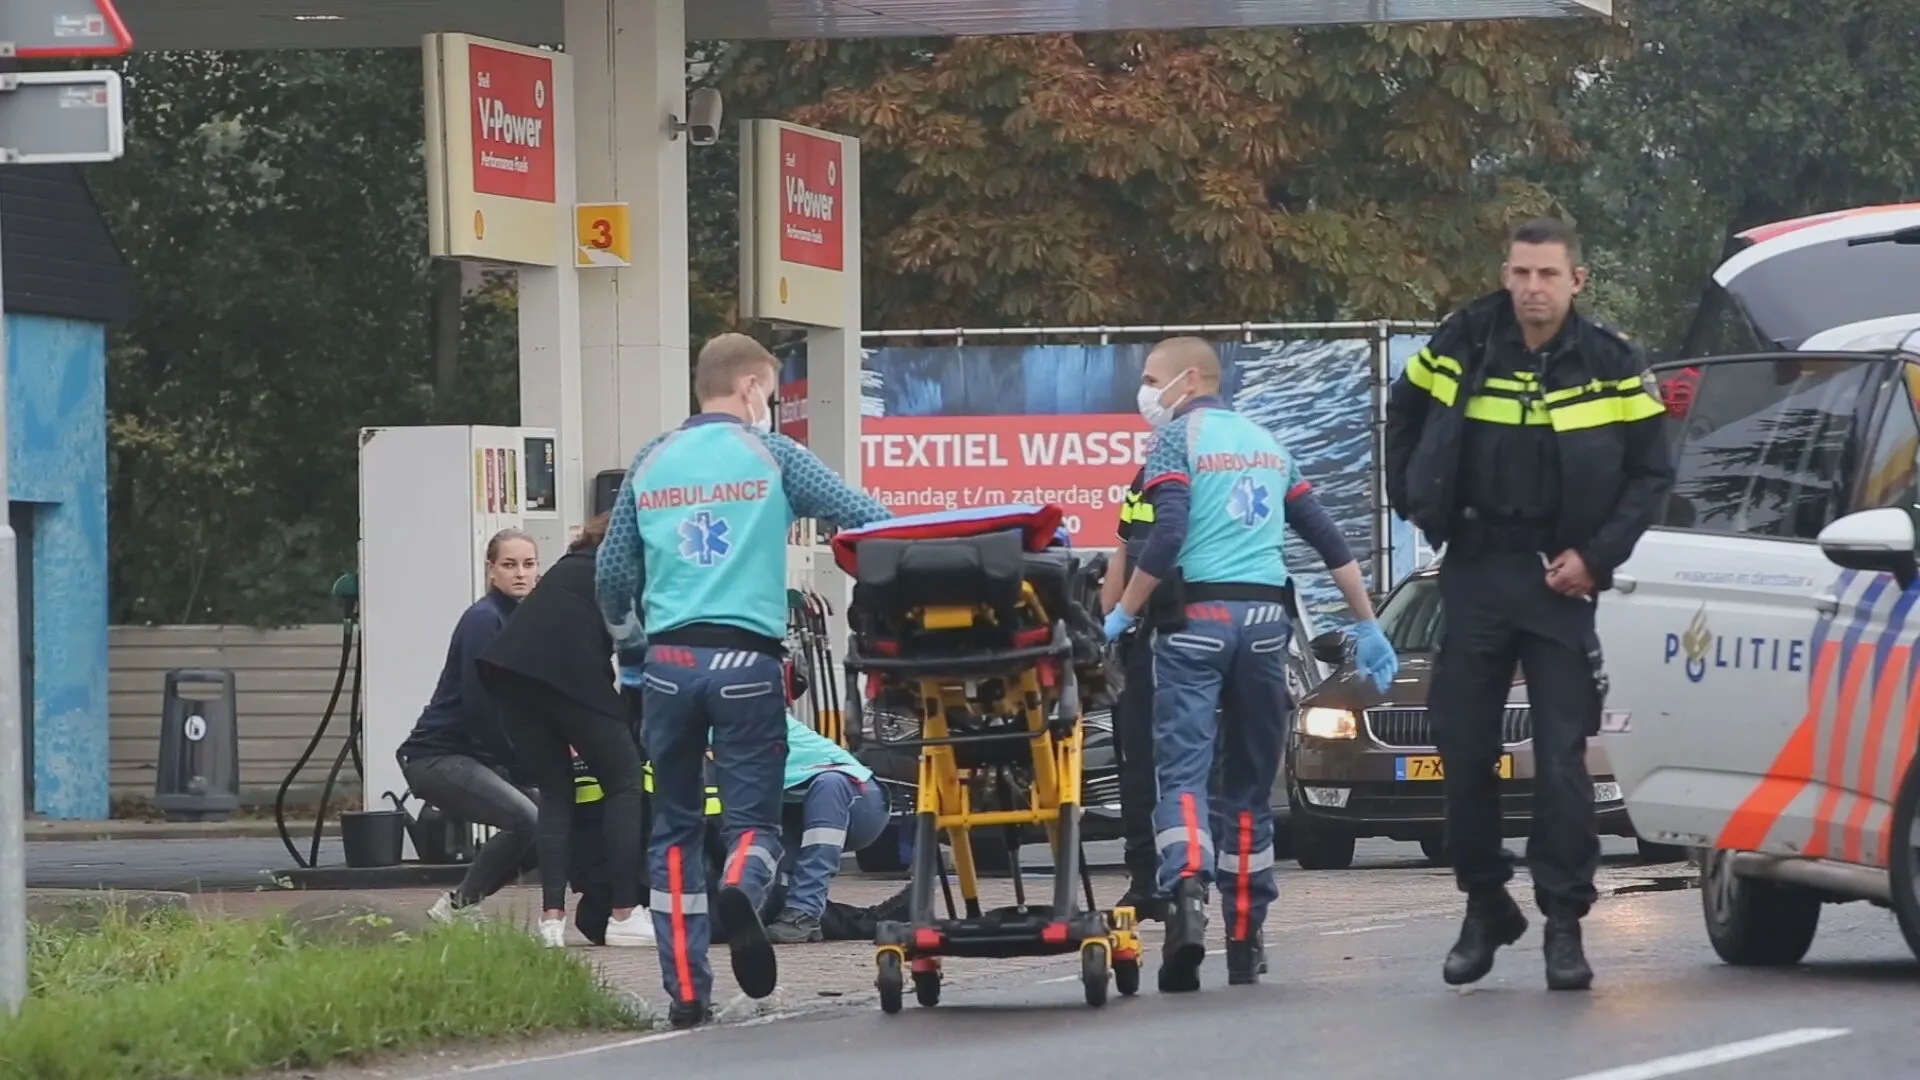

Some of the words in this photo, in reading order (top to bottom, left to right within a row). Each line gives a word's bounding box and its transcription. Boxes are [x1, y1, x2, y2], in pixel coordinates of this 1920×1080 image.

[478, 97, 542, 148] V-Power
[785, 175, 834, 221] V-Power
[592, 219, 612, 249] 3
[861, 433, 1008, 467] TEXTIEL
[1196, 451, 1287, 478] AMBULANCE
[638, 479, 769, 510] AMBULANCE
[963, 486, 1005, 508] t/m
[1011, 484, 1103, 510] zaterdag
[1664, 632, 1804, 683] POLITIE
